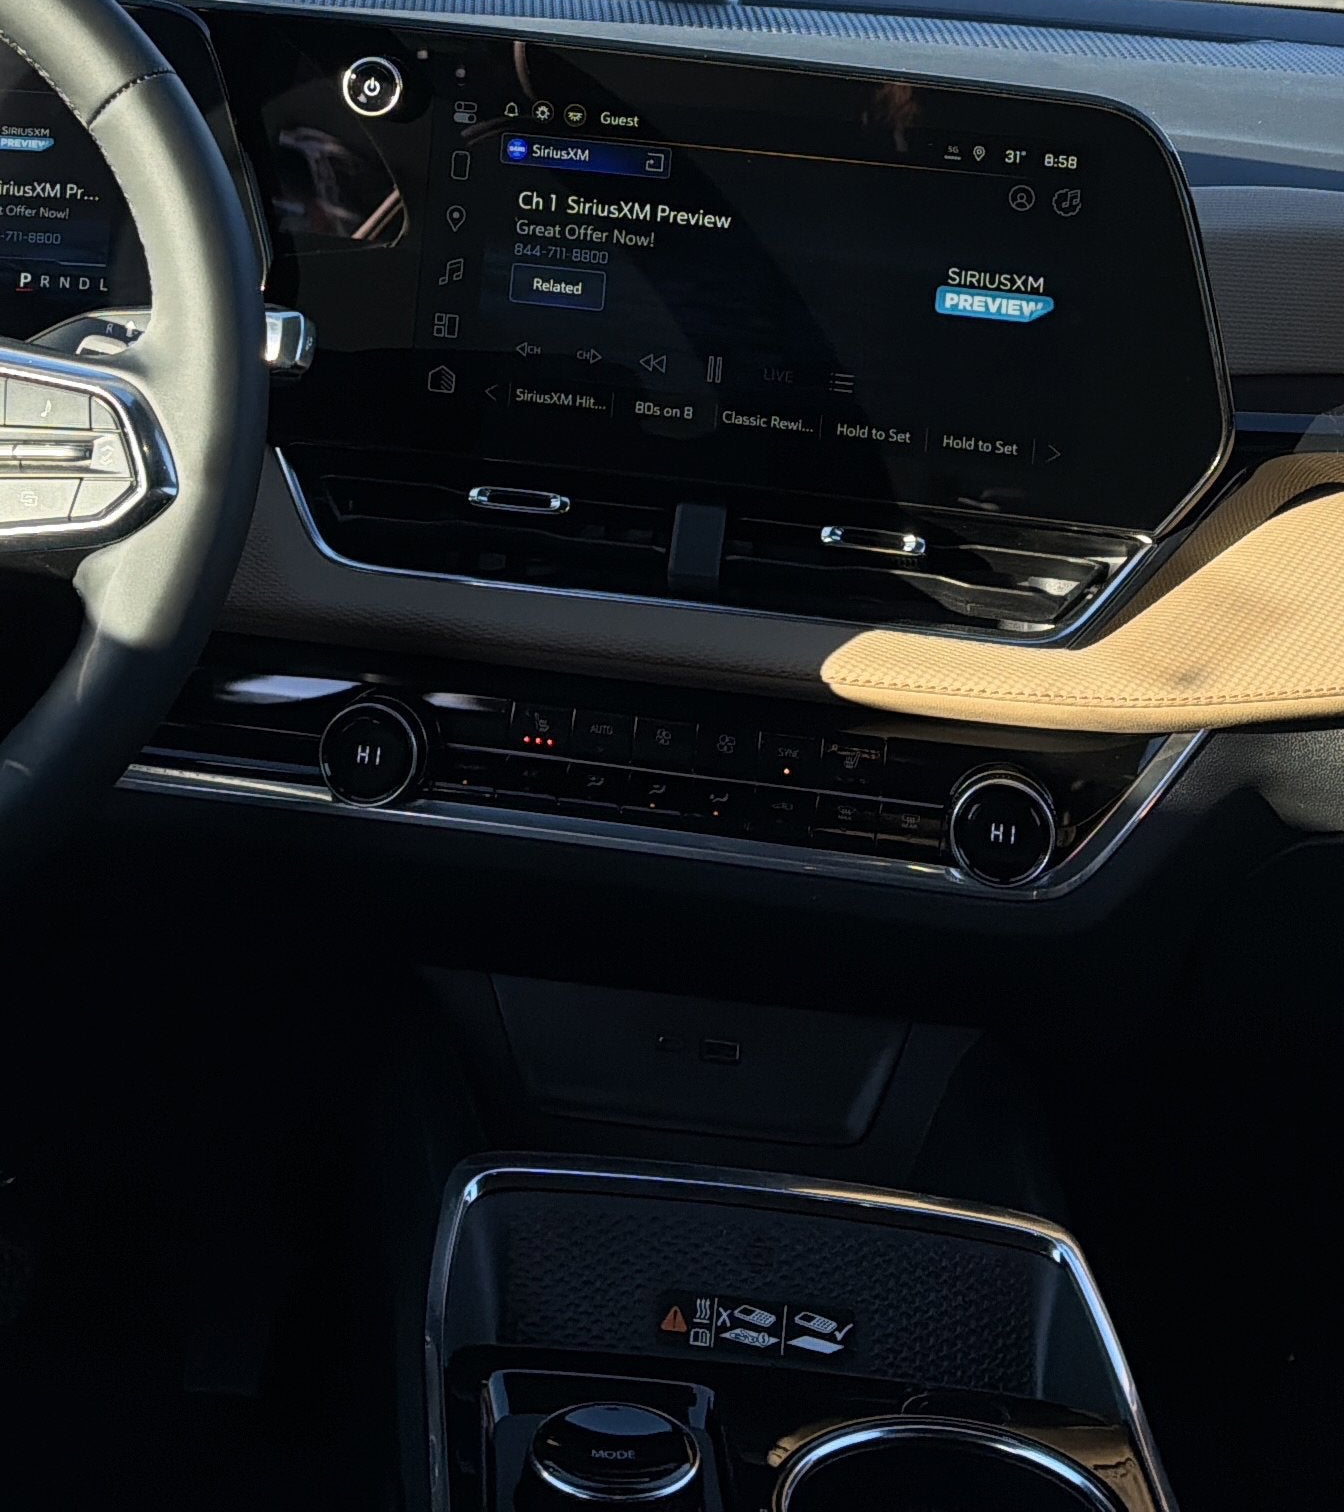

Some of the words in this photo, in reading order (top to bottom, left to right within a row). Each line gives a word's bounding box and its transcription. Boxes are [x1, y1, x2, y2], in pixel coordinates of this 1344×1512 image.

[600, 111, 640, 128] Guest
[0, 138, 50, 149] PREVIEW
[532, 144, 589, 161] SiriusXM
[1044, 153, 1078, 169] 8:58
[6, 205, 37, 217] Offer
[39, 207, 69, 219] Now!
[518, 191, 543, 210] Ch
[550, 194, 557, 212] 1
[566, 196, 651, 221] SiriusXM
[657, 205, 732, 229] Preview
[516, 219, 561, 239] Great
[565, 224, 609, 243] Offer
[613, 228, 655, 247] Now!
[514, 243, 609, 264] 844-711-8800
[19, 272, 32, 288] P
[40, 275, 50, 288] R
[59, 276, 70, 289] N
[79, 277, 90, 290] D
[99, 278, 108, 291] L
[533, 278, 582, 295] Related
[947, 267, 1044, 293] SIRIUSXM
[944, 292, 1045, 317] PREVIEW
[528, 345, 541, 355] CH
[576, 350, 590, 360] CH
[763, 368, 794, 384] LIVE
[515, 388, 572, 406] SiriusXM
[634, 401, 661, 416] 80s
[664, 407, 680, 418] on
[683, 406, 694, 419] 8
[722, 411, 767, 428] Classic
[837, 423, 868, 439] Hold
[871, 428, 885, 440] to
[888, 429, 911, 444] Set
[943, 435, 975, 451] Hold
[977, 440, 992, 452] to
[995, 441, 1018, 456] Set
[590, 724, 613, 736] AUTO
[356, 744, 381, 766] HI
[990, 823, 1016, 845] HI
[591, 1448, 636, 1460] MODE
